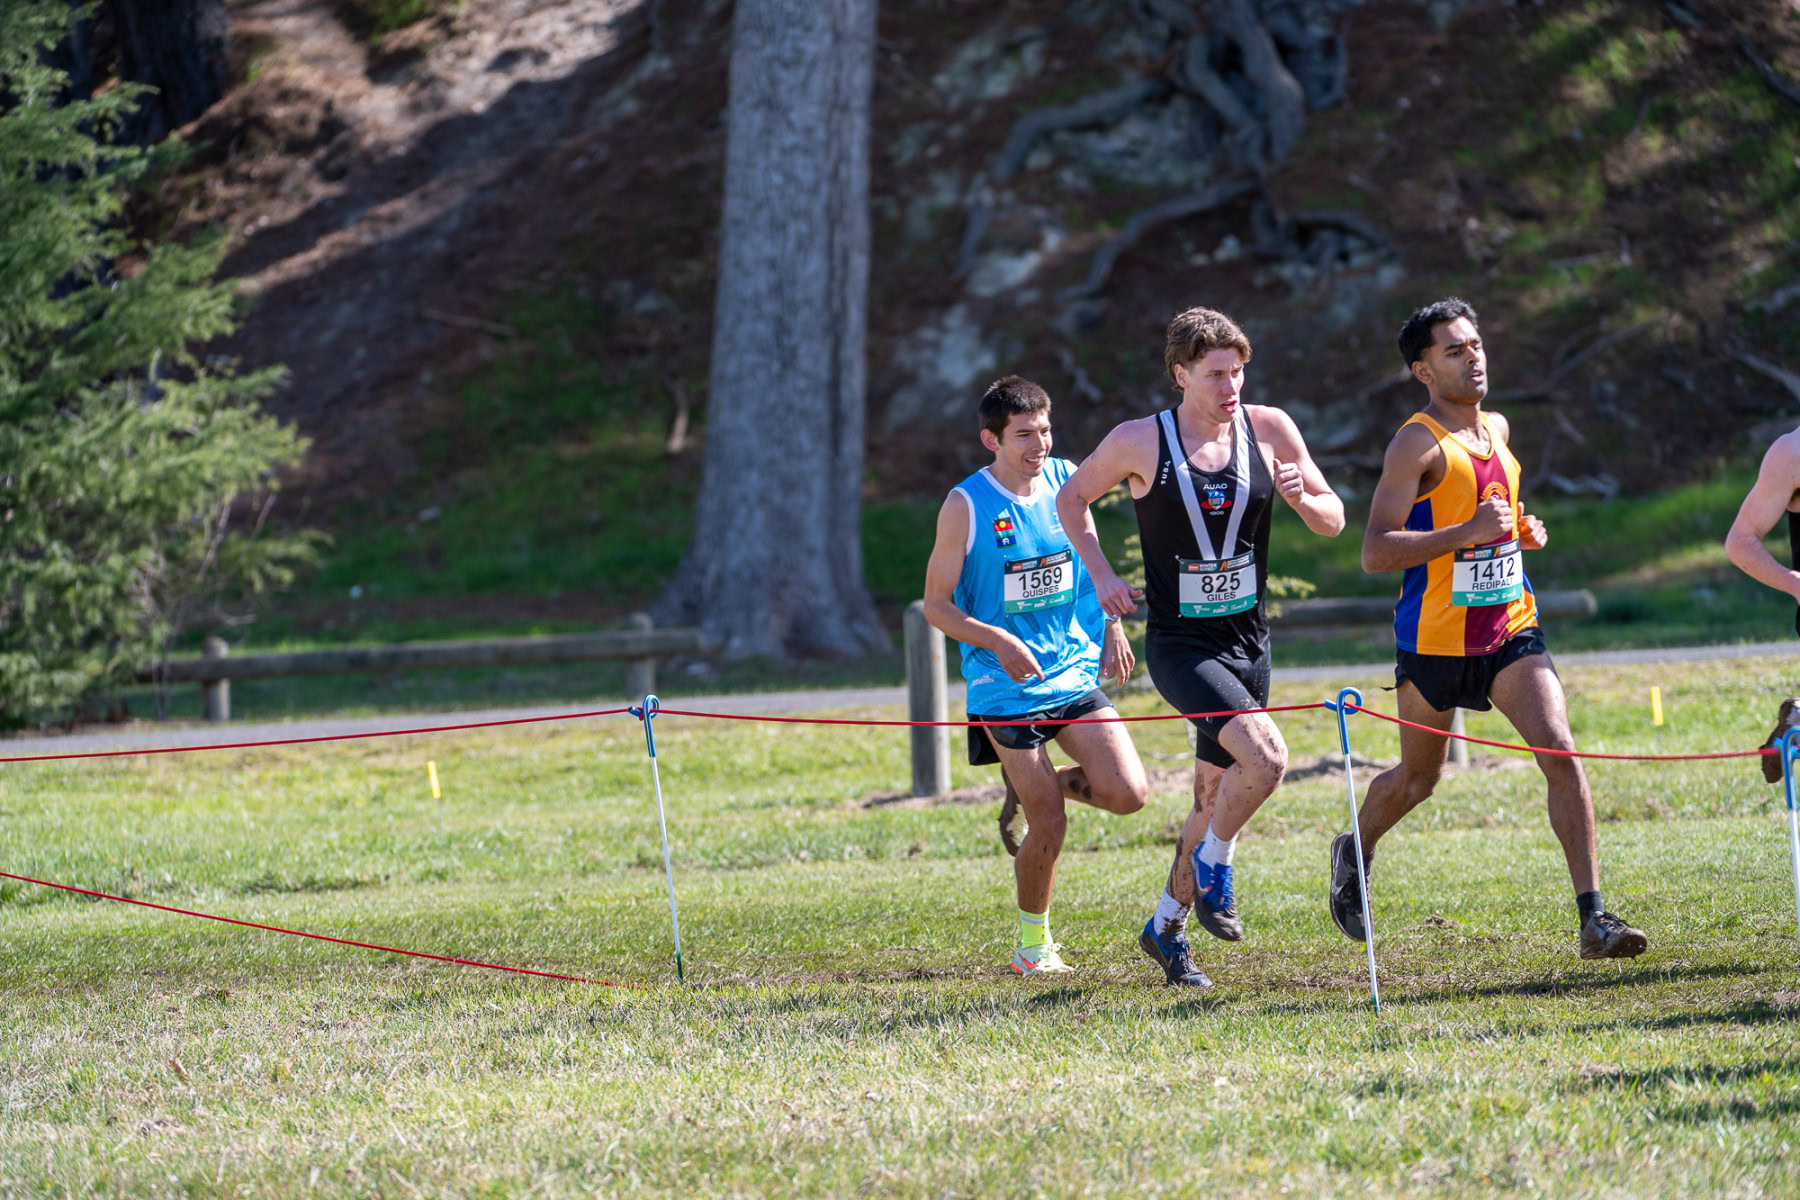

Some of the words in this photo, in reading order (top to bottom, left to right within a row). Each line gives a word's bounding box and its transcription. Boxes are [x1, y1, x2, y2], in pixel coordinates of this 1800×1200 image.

[1018, 566, 1062, 591] 1569
[1469, 556, 1515, 582] 1412
[1022, 584, 1060, 599] QUISPES
[1201, 571, 1241, 594] 825
[1207, 591, 1236, 602] GILES
